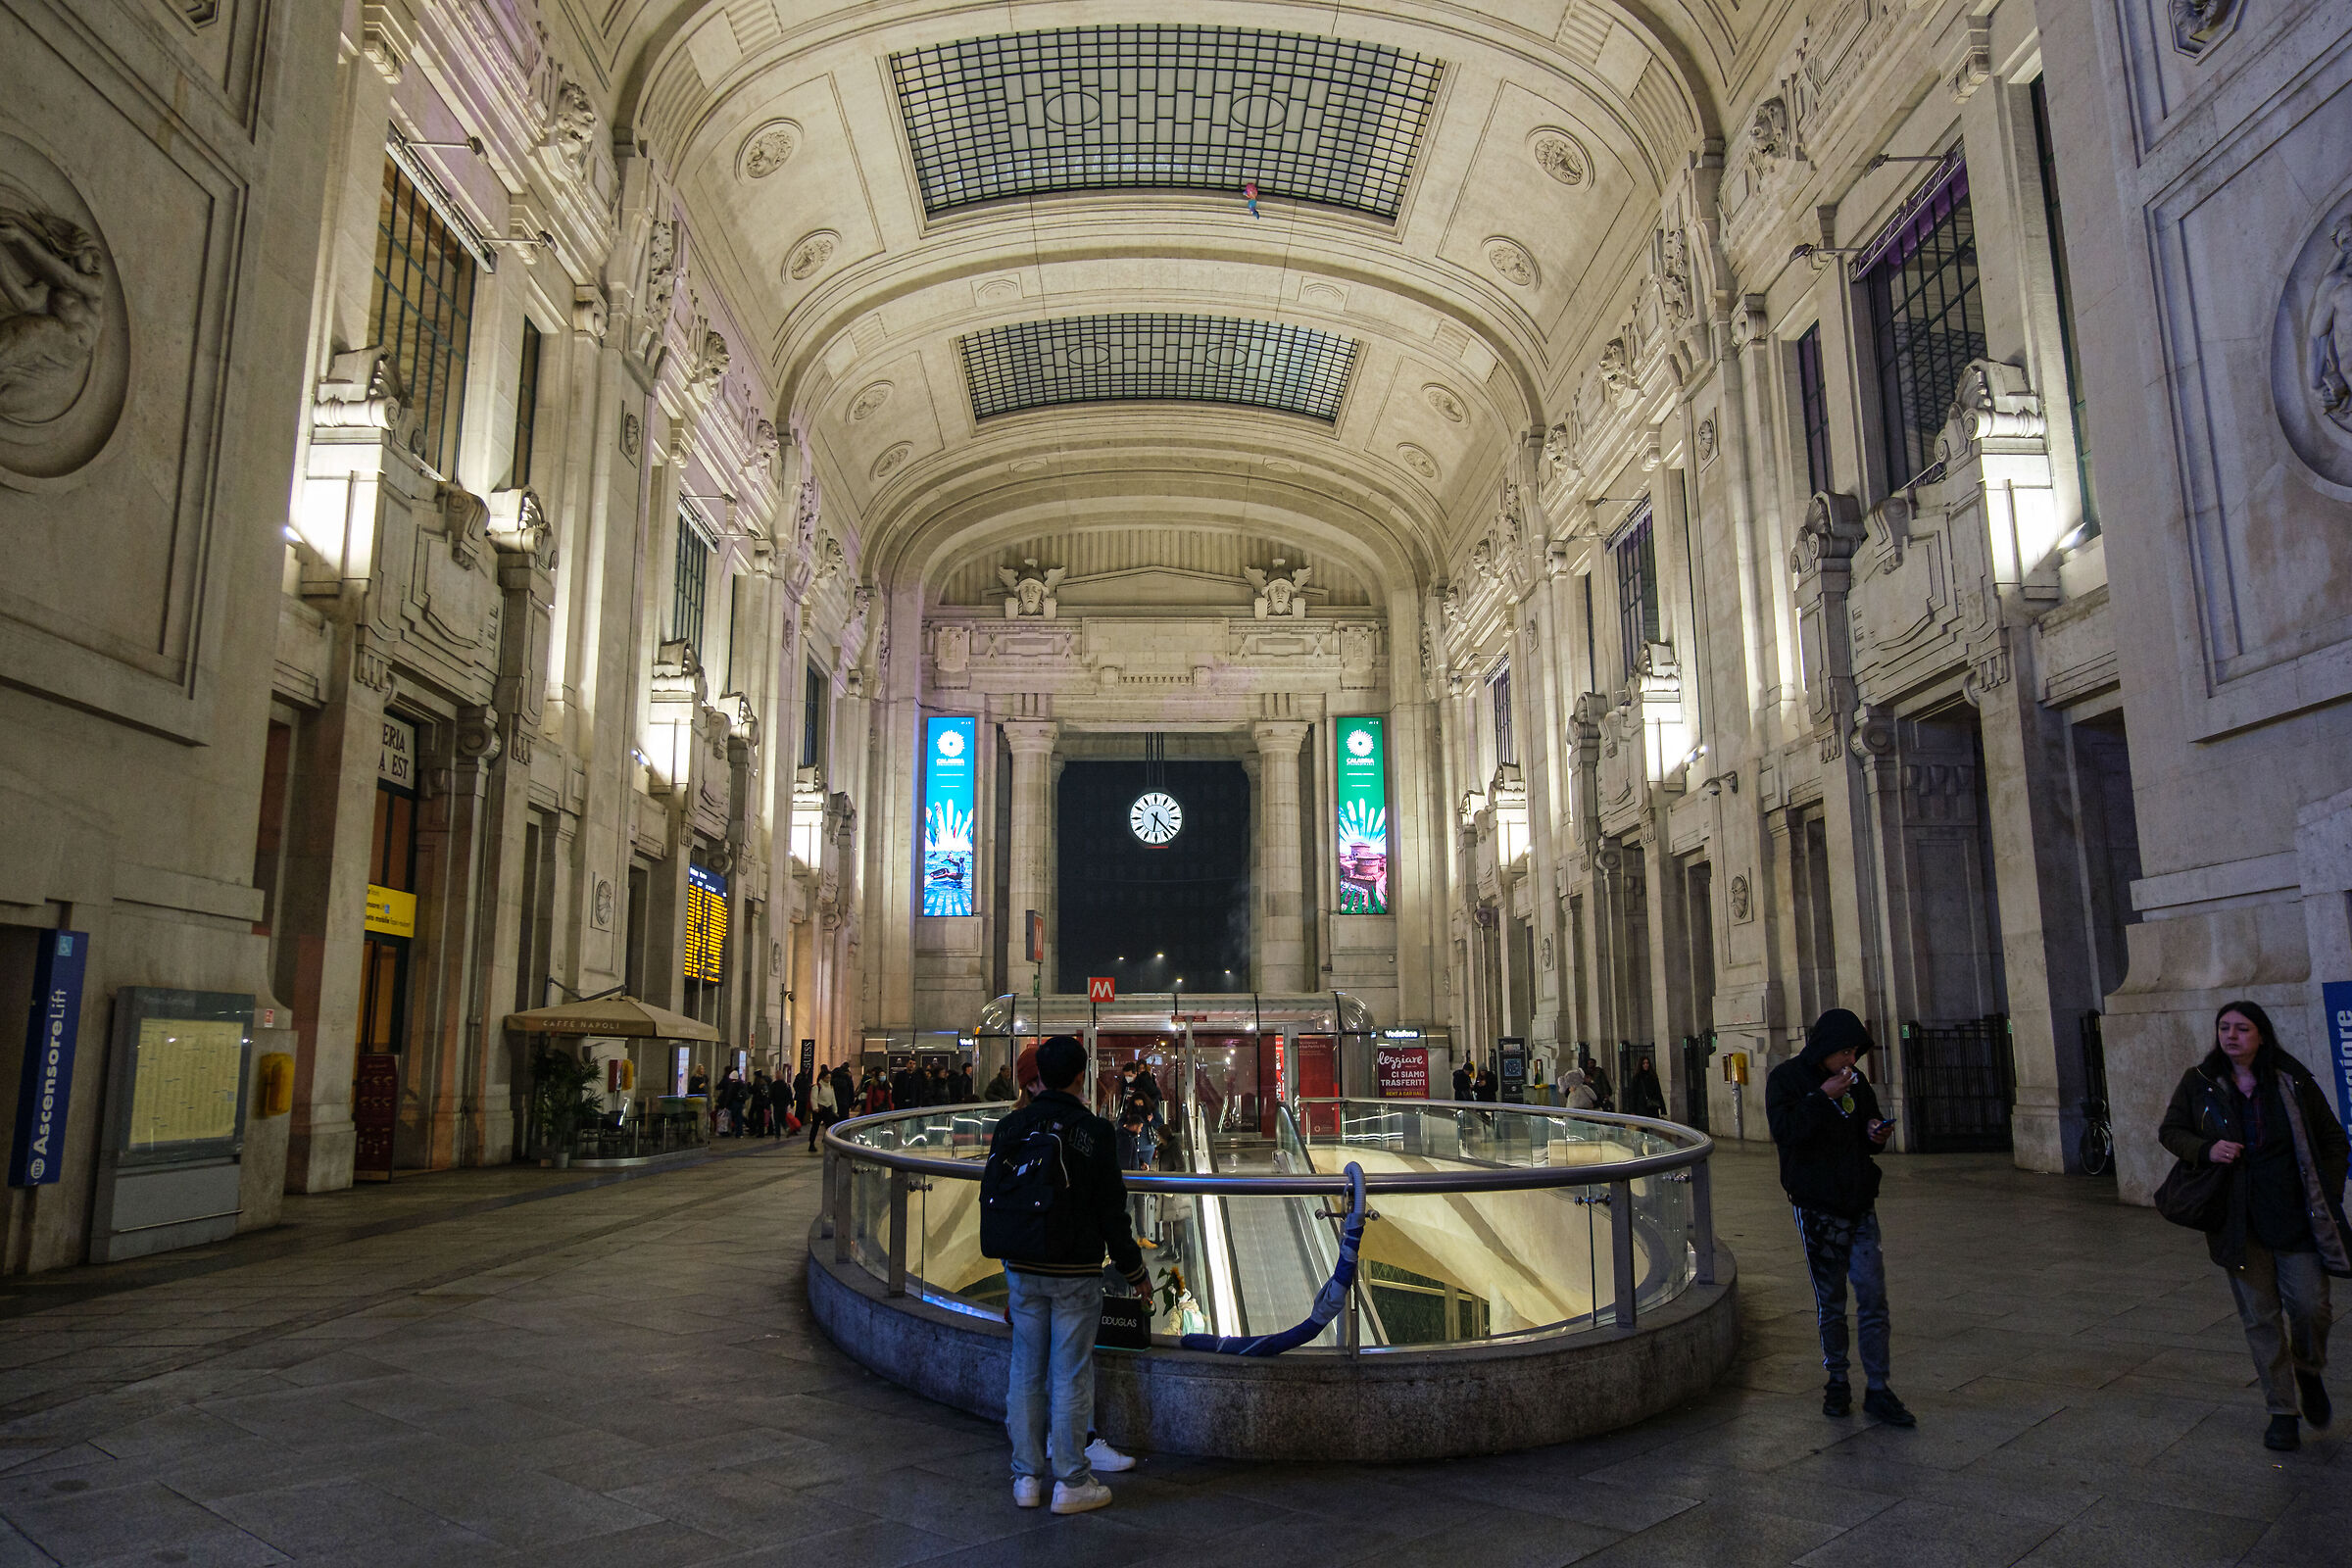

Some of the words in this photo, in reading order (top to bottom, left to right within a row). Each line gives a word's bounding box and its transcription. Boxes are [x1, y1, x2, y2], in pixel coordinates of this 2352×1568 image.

[382, 722, 405, 753] ERIA
[391, 754, 409, 779] EST
[1091, 981, 1113, 998] M
[580, 1020, 620, 1030] NAPOLI
[803, 1041, 811, 1068] GUESS
[33, 1020, 63, 1154] Ascensore
[50, 989, 67, 1018] Lift
[1102, 1315, 1137, 1328] DOUGLAS
